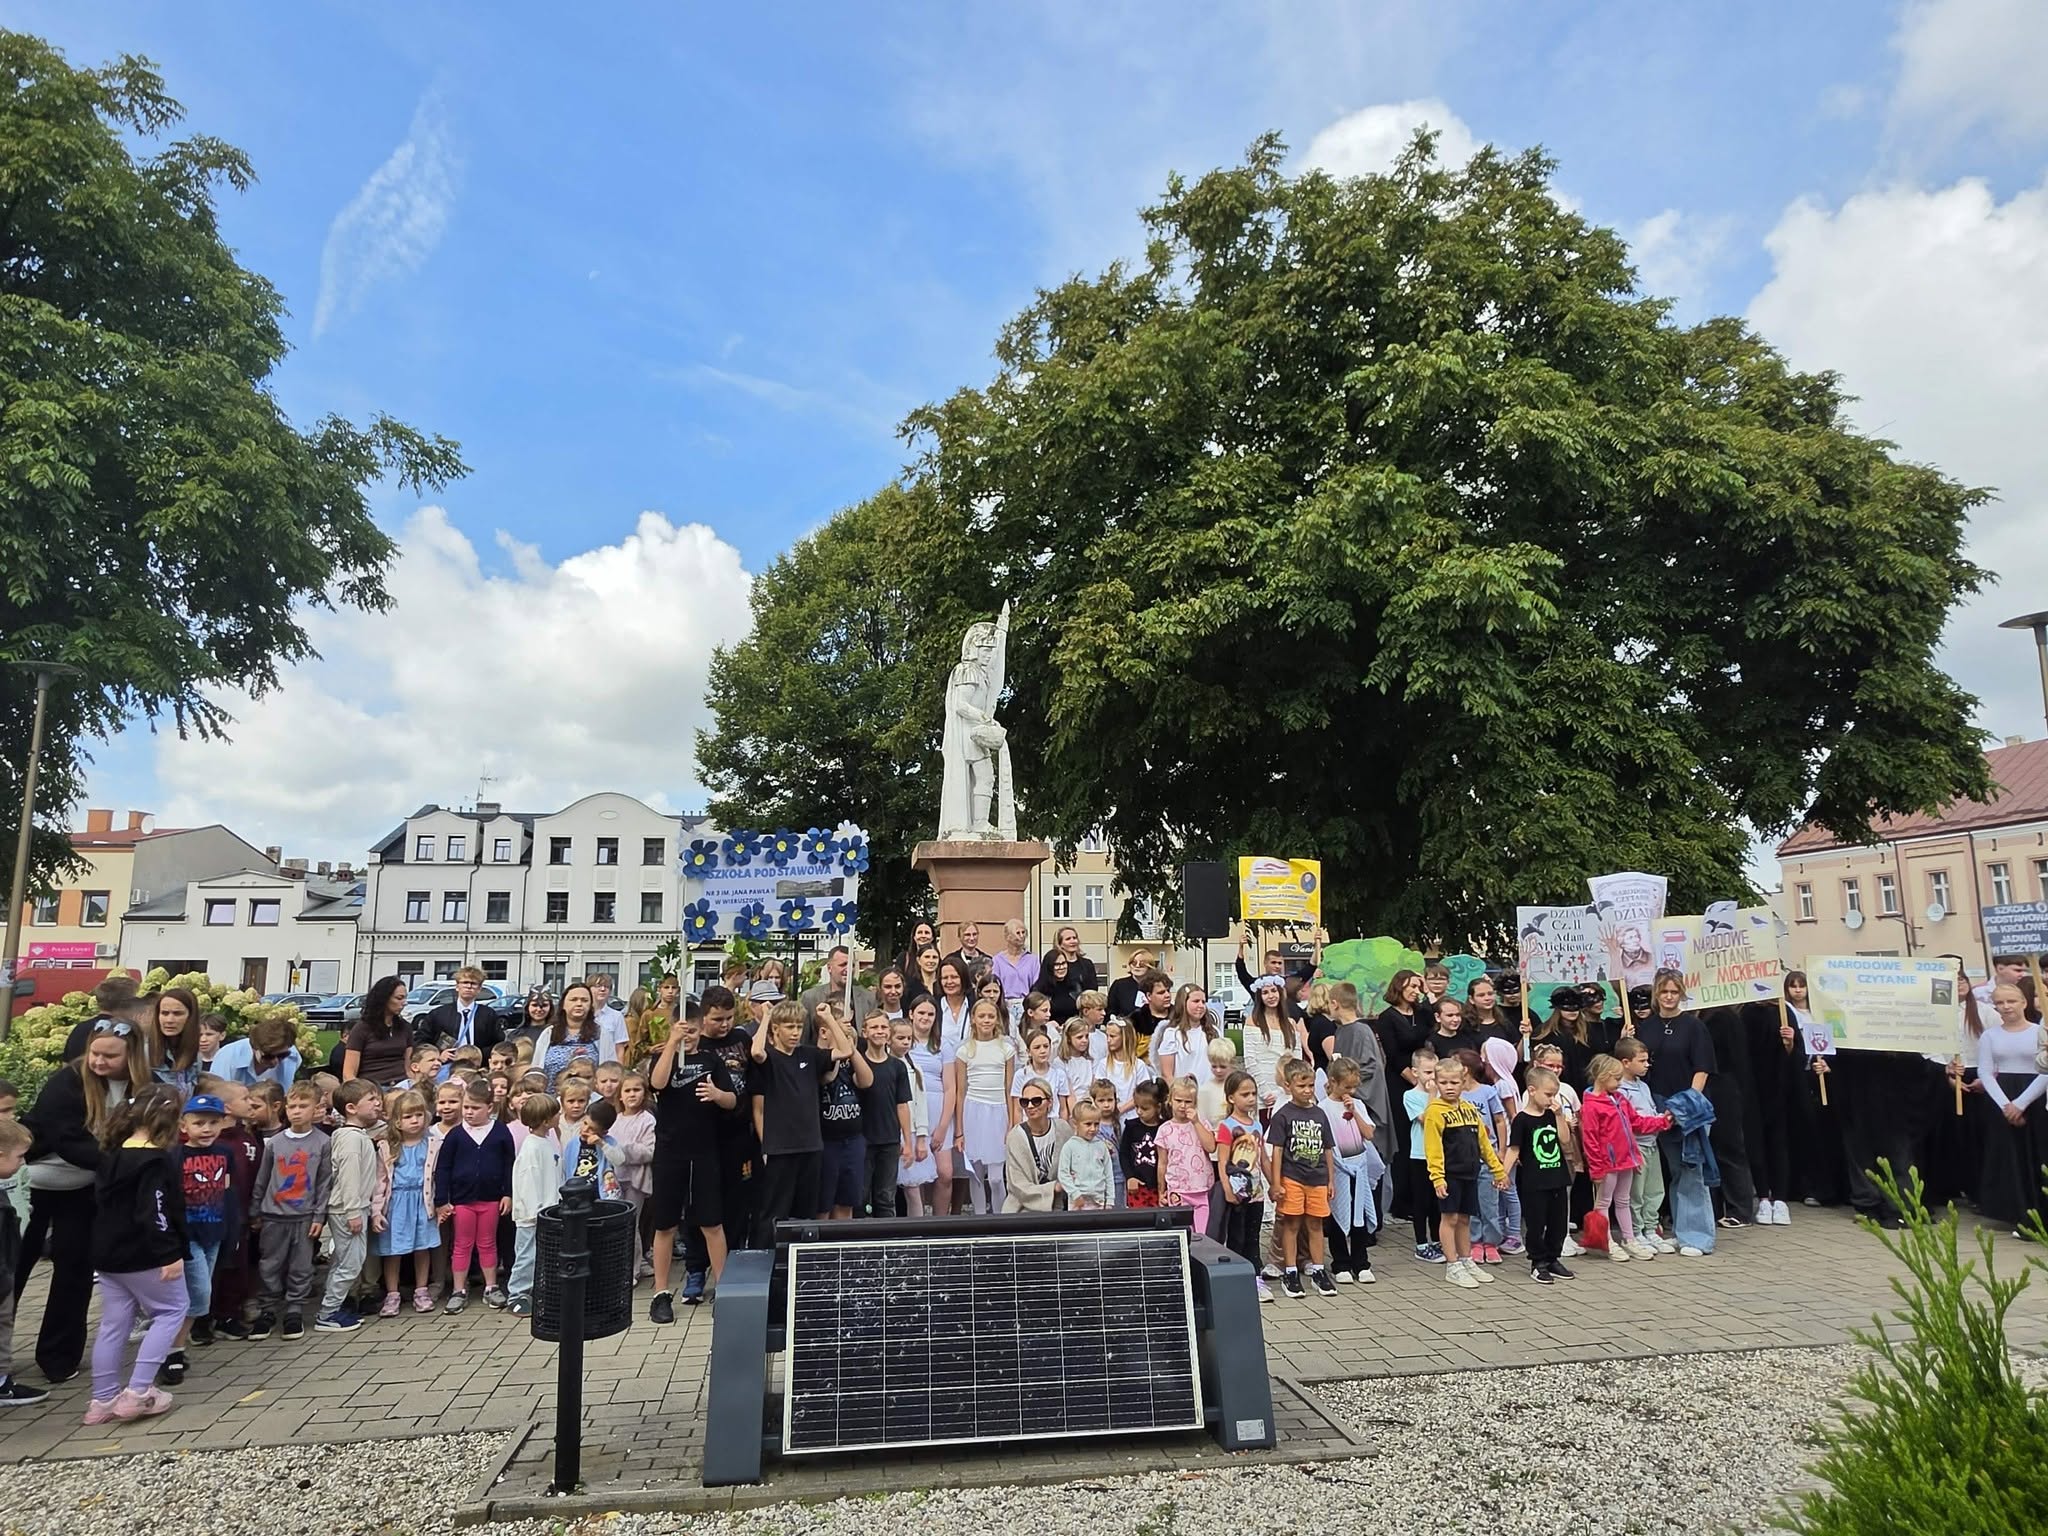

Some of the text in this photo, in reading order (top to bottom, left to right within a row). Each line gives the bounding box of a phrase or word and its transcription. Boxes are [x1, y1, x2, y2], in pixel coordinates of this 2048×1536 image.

[708, 868, 751, 880] SZKOŁA
[1554, 932, 1585, 942] Adam
[1693, 929, 1751, 955] NARODOWE
[1704, 945, 1757, 969] CZYTANIE
[1827, 960, 1902, 971] NARODOWE
[1717, 959, 1780, 985] MICKIEWICZ
[1856, 974, 1918, 985] CZYTANIE
[1701, 981, 1747, 1003] DZIADY
[1441, 1108, 1482, 1125] BATMAN
[183, 1154, 227, 1171] MARVE
